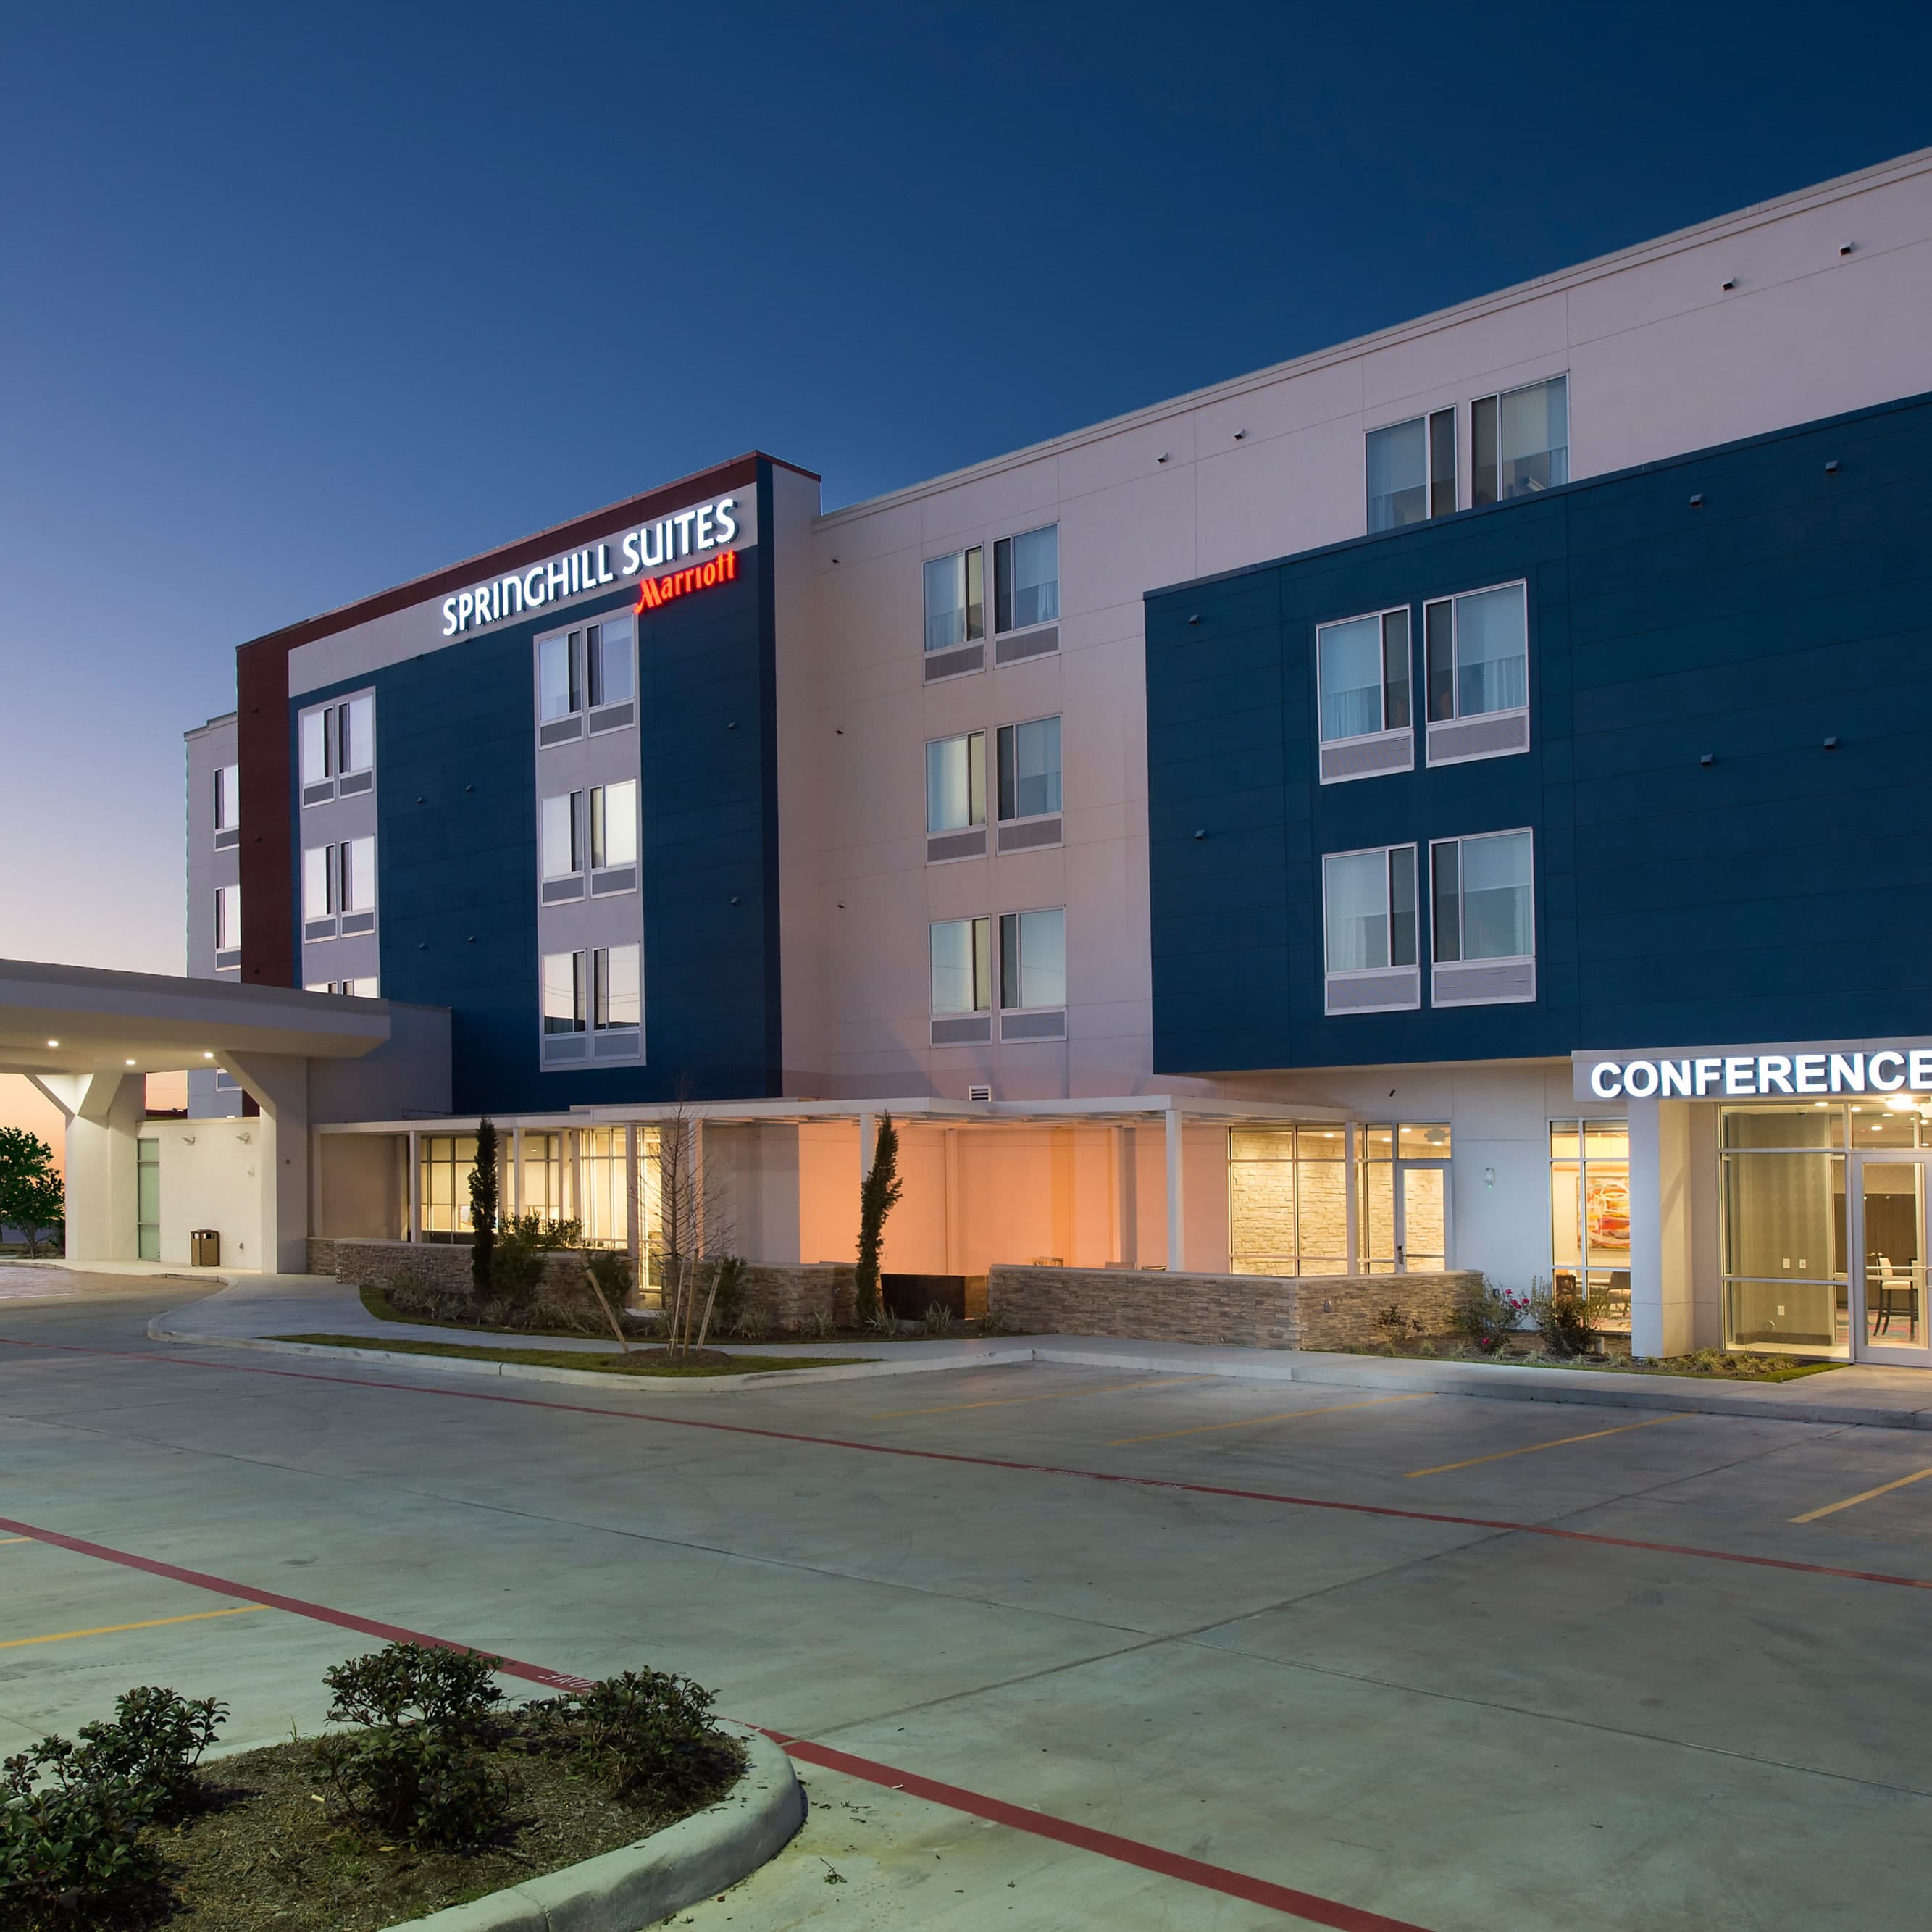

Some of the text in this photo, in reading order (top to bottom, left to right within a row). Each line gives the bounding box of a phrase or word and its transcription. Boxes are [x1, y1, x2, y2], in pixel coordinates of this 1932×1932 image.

[442, 498, 737, 637] SPRINGHILL SUITES
[633, 549, 736, 614] Marriott
[1590, 1050, 1932, 1098] CONFERENCE
